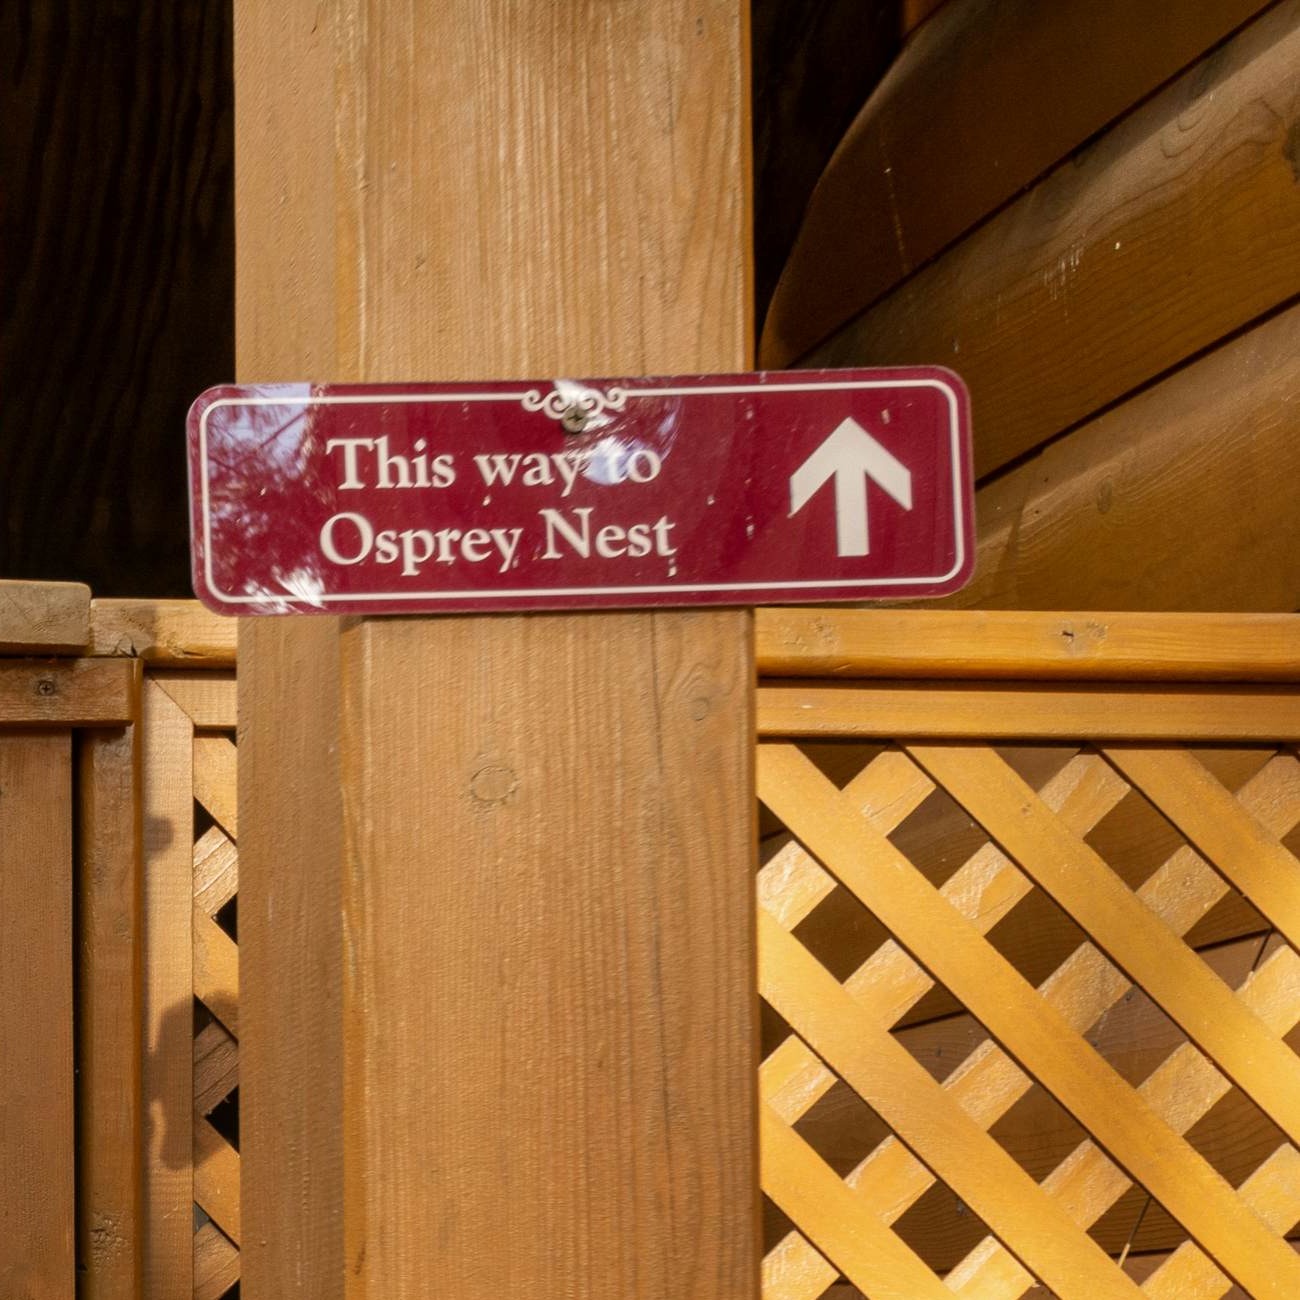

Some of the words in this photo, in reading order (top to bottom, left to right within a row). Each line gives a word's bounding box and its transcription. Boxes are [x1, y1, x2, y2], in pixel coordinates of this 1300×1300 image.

[325, 434, 456, 490] This
[473, 452, 584, 498] way
[607, 443, 662, 485] to
[319, 511, 524, 577] Osprey
[537, 507, 678, 562] Nest
